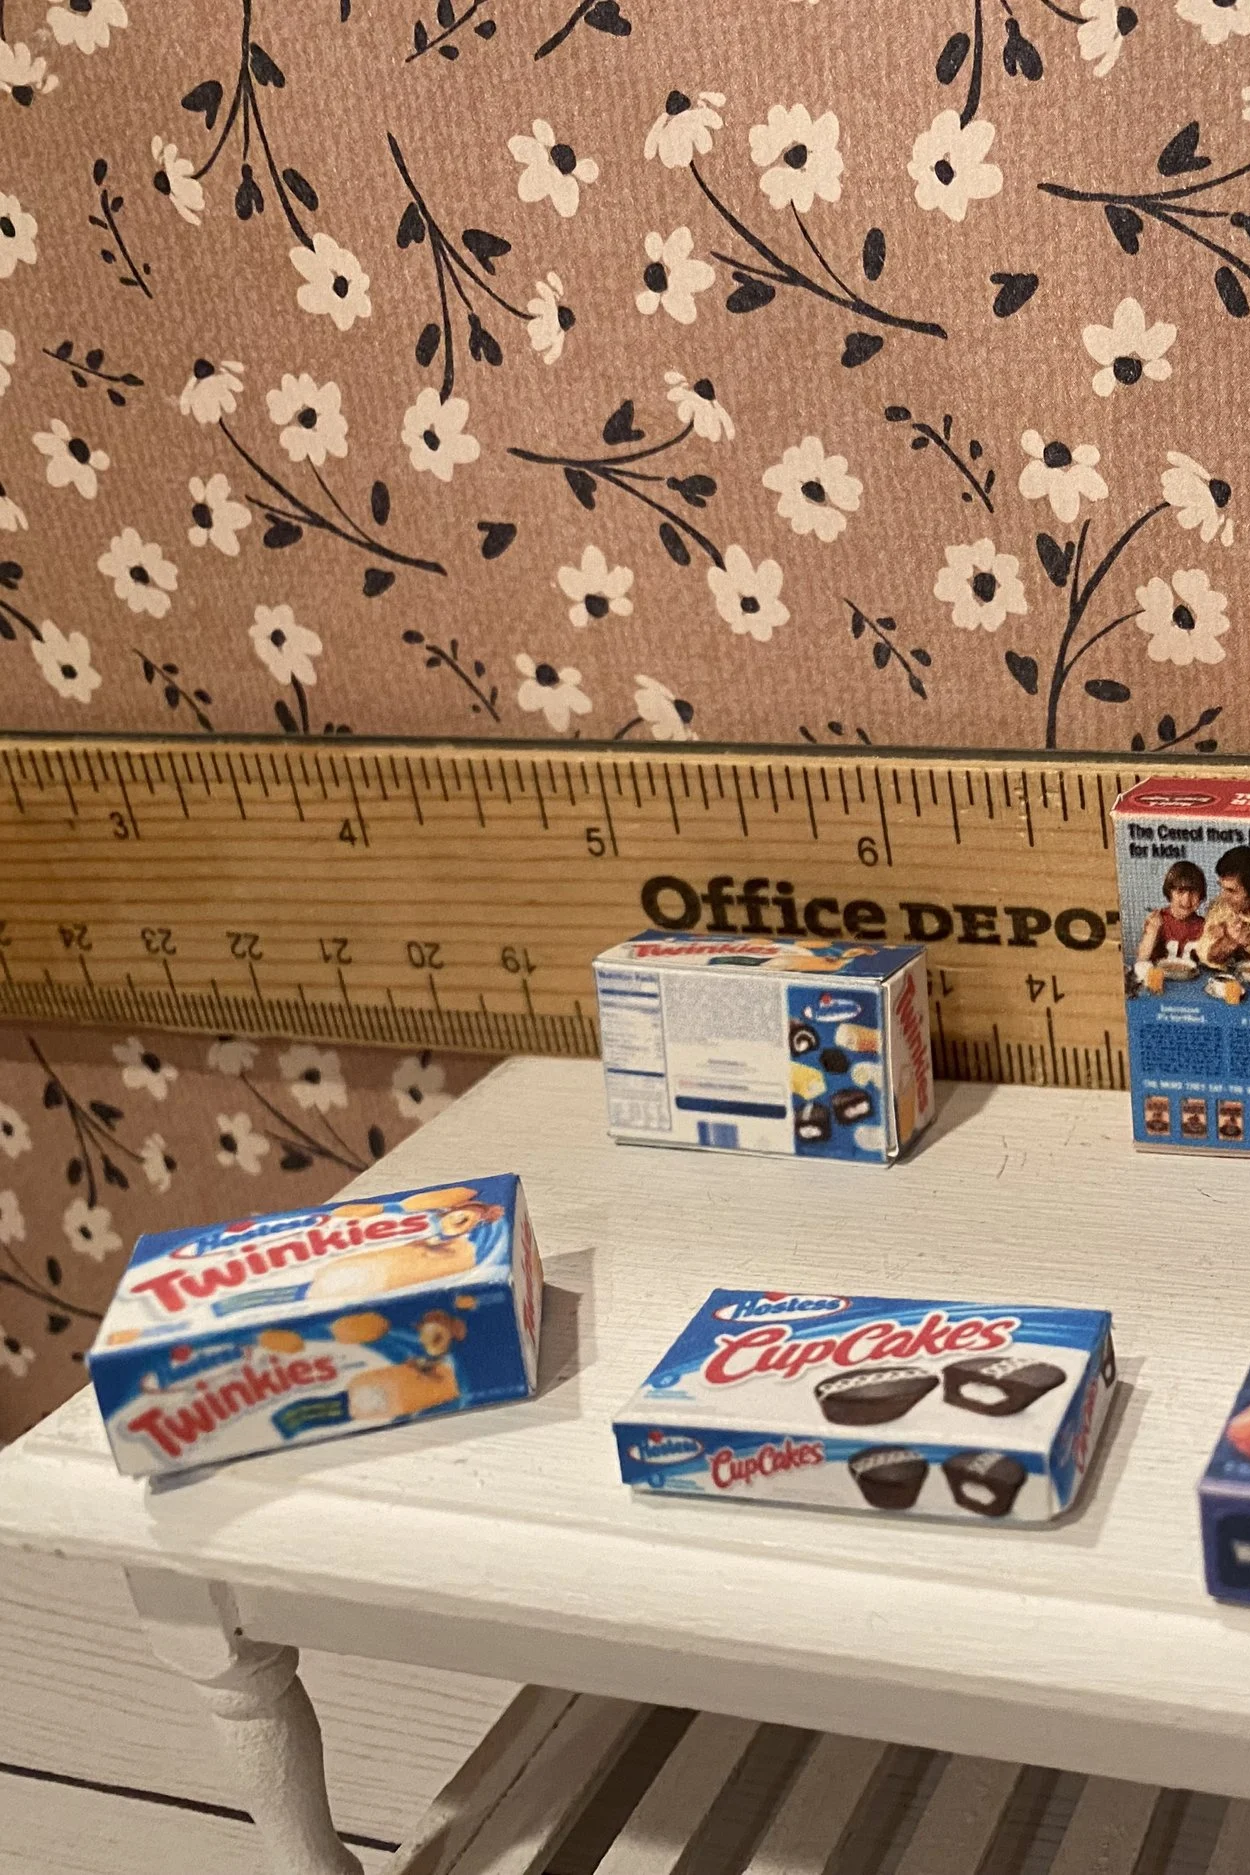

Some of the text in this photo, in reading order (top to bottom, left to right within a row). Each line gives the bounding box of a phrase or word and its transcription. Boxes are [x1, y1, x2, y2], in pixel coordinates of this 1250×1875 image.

[109, 812, 129, 839] 3
[339, 819, 358, 845] 4
[1127, 823, 1153, 840] The
[1157, 825, 1203, 842] Cereal
[1206, 827, 1244, 843] that's
[586, 828, 606, 856] 5
[857, 837, 879, 867] 6
[1129, 842, 1187, 859] for kids!
[640, 875, 1120, 951] Office DEPO
[140, 928, 177, 955] 23
[226, 932, 263, 960] 22
[318, 938, 353, 965] 21
[406, 941, 444, 969] 20
[634, 943, 780, 958] Twinkies
[501, 947, 537, 974] 19
[1025, 973, 1065, 1004] 14
[129, 1212, 432, 1314] Twinkies
[727, 1296, 845, 1320] Hostess
[702, 1312, 1020, 1386] CupCakes
[127, 1353, 339, 1459] Twinkies
[707, 1436, 827, 1489] CupCakes
